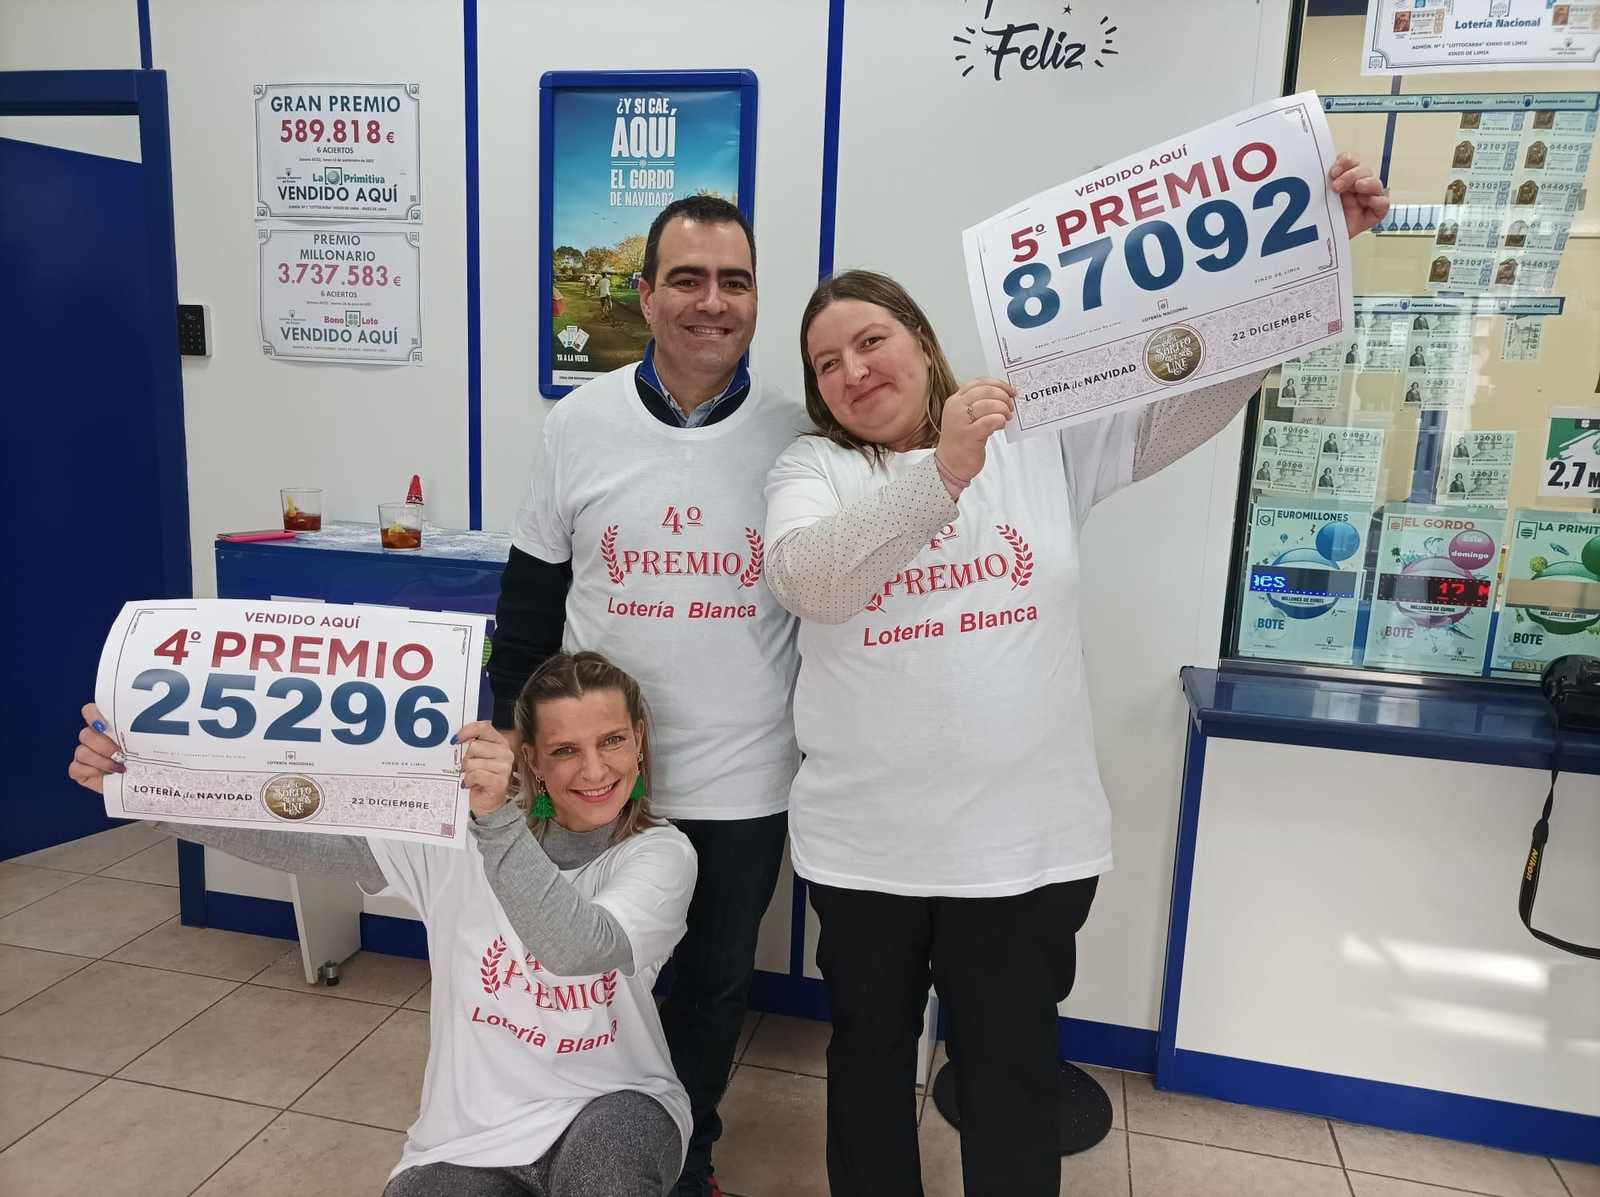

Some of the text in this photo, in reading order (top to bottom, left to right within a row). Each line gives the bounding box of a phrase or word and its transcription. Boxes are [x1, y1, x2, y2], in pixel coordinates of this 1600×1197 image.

[1455, 17, 1541, 30] Lotería Nacional
[981, 22, 1086, 81] Feliz
[271, 95, 401, 113] GRAN PREMIO
[616, 97, 670, 114] ¿Y SI CAE
[280, 119, 395, 144] 589.818 €
[611, 108, 678, 159] AQUÍ
[1549, 143, 1580, 151] 64465
[312, 173, 324, 182] La
[343, 174, 385, 184] Primitiva
[611, 169, 675, 190] EL GORDO
[1075, 144, 1188, 198] VENDIDO AQUÍ
[278, 184, 398, 203] VENDIDO AQUÍ
[1468, 182, 1499, 190] 92102
[1540, 183, 1570, 191] 64465
[610, 192, 674, 207] DE NAVIDAD?
[1010, 141, 1277, 263] 5º PREMIO
[313, 234, 361, 246] PREMIO
[300, 249, 376, 262] MILLONARIO
[1002, 176, 1319, 330] 87092
[1452, 258, 1483, 266] 92102
[278, 263, 402, 287] 3.737.583 €
[1284, 266, 1300, 276] LIMIA
[326, 291, 358, 299] ACIERTOS
[324, 316, 379, 325] Bono Loto
[1141, 305, 1189, 323] LOTERÍA NACIONAL
[1232, 309, 1313, 342] 22 DICIEMBRE
[280, 326, 398, 345] VENDIDO AQUÍ
[568, 354, 574, 362] LA
[574, 354, 589, 362] VENTA
[1024, 364, 1137, 402] LOTERÍA de NAVIDAD
[1547, 461, 1587, 490] 2,7
[661, 506, 703, 535] 4º
[1277, 510, 1349, 522] EUROMILLONES
[1403, 517, 1475, 531] EL GORDO
[1538, 522, 1600, 535] LA PRIMIT
[623, 550, 743, 577] PREMIO
[1451, 550, 1489, 560] domingo
[883, 553, 1010, 598] PREMIO
[1439, 582, 1465, 594] 17
[607, 596, 757, 619] Lotería Blanca
[244, 611, 361, 629] VENDIDO AQUÍ
[863, 605, 1038, 647] Lotería Blanca
[1257, 617, 1285, 630] BOTE
[1384, 626, 1414, 639] BOTE
[1513, 632, 1544, 646] BOTE
[153, 628, 433, 681] 4º PREMIO
[130, 668, 450, 748] 25296
[134, 784, 253, 801] LOTERÍA de NAVIDAD
[351, 797, 430, 810] 22 DICIEMBRE
[1525, 848, 1539, 881] Nikon
[472, 1006, 547, 1048] Lotería
